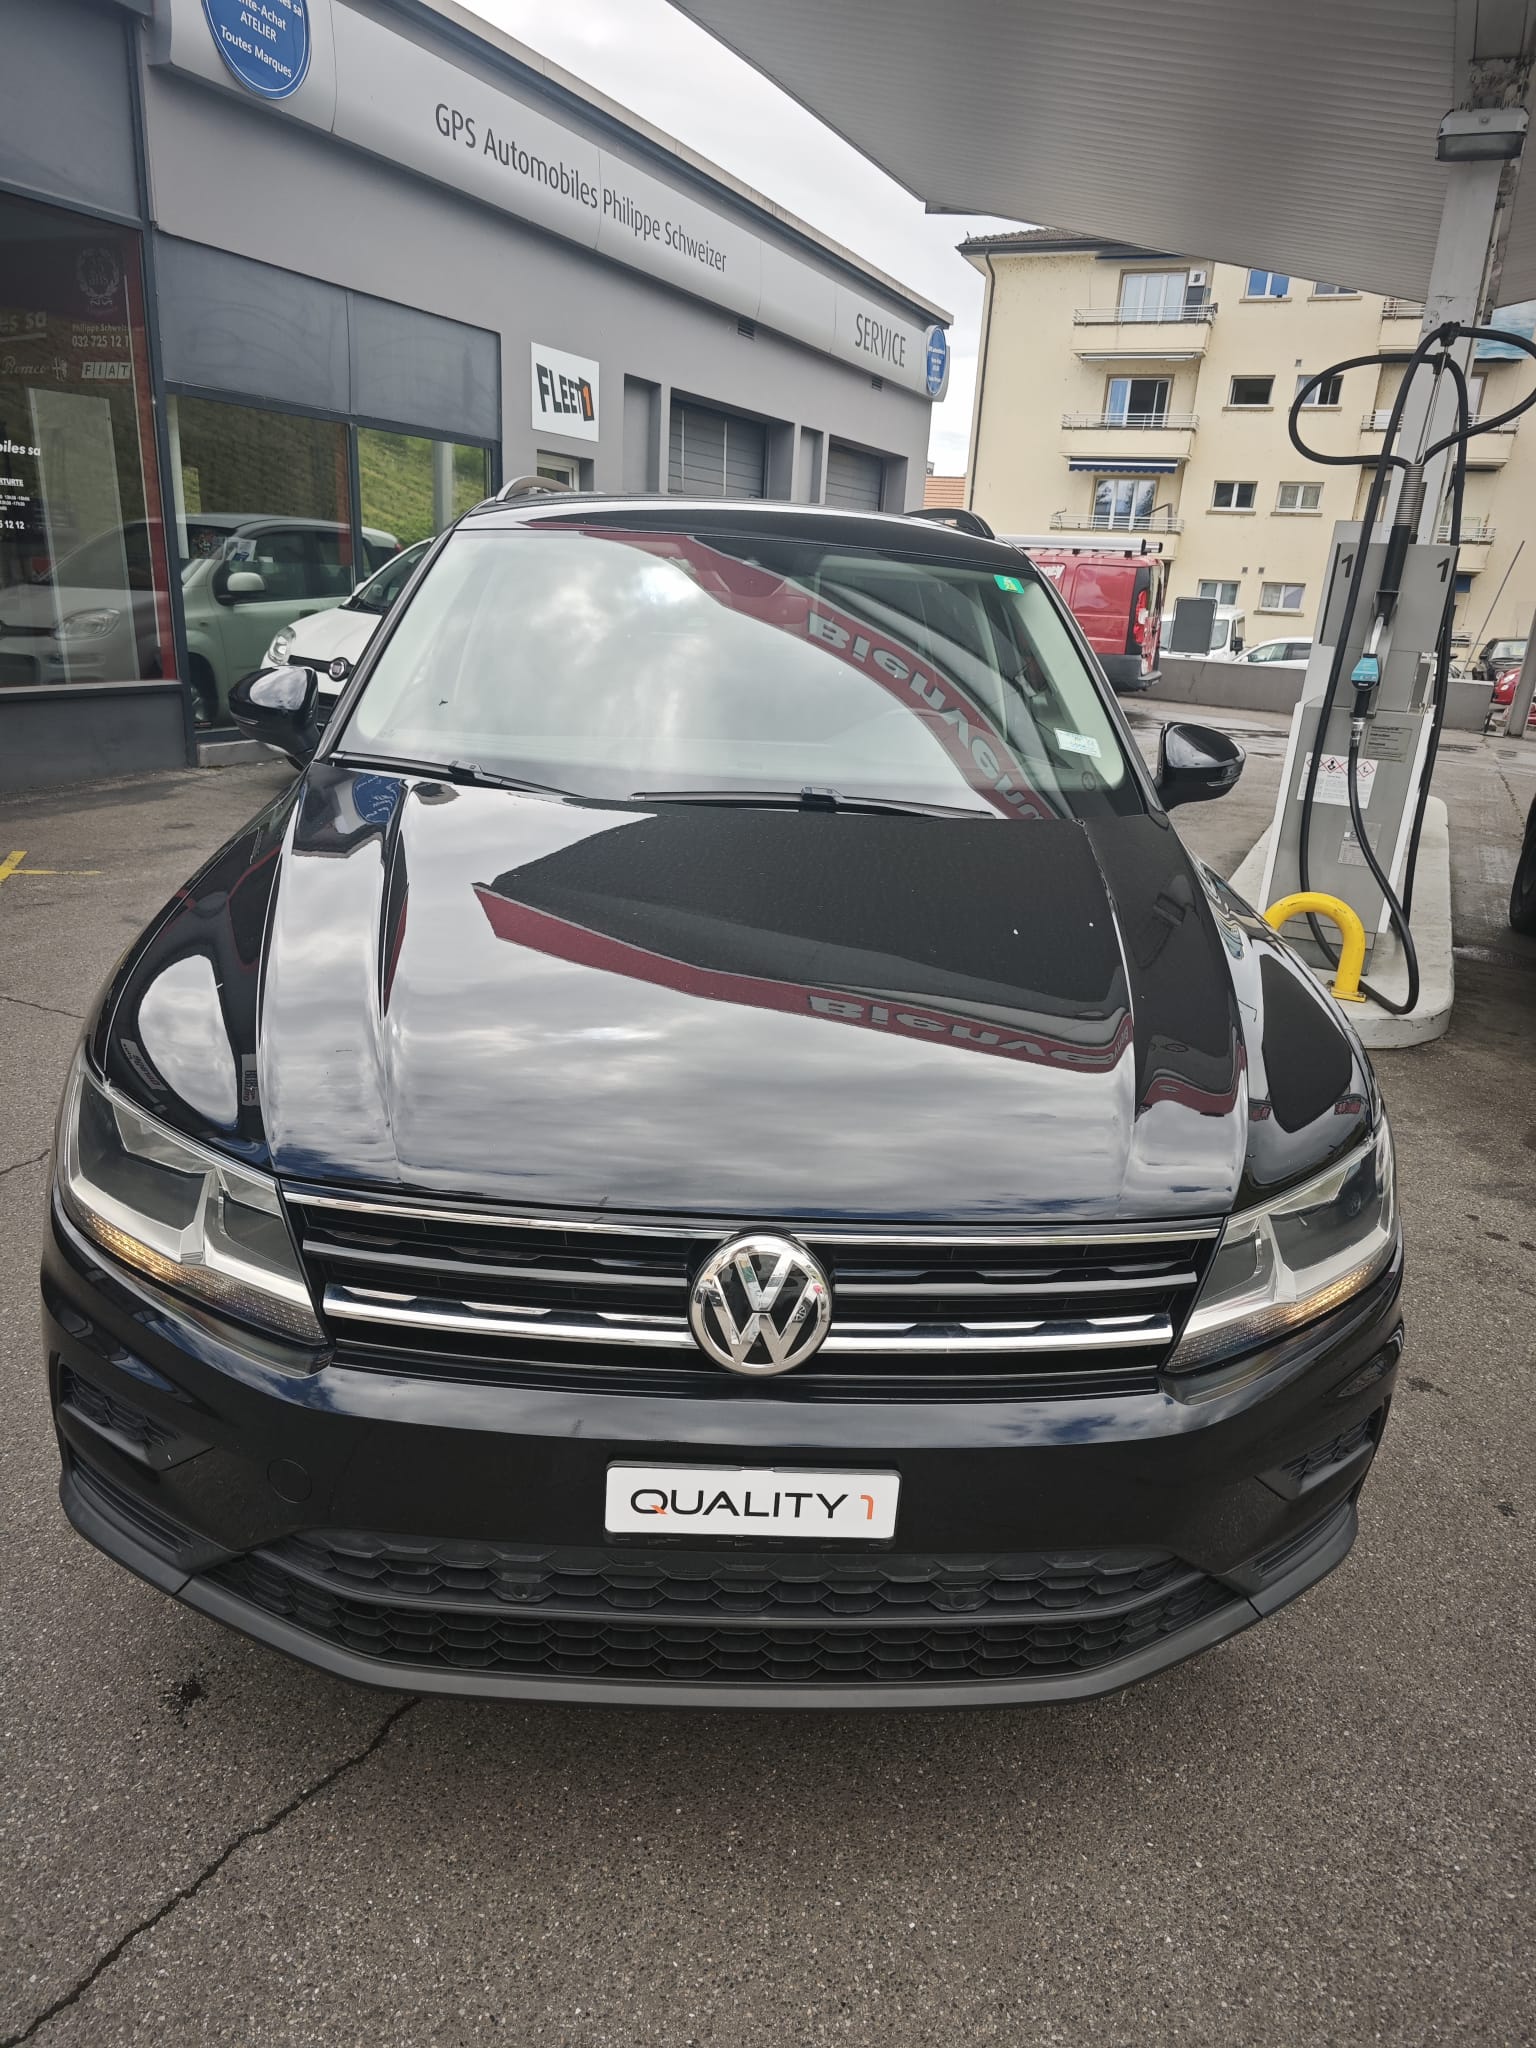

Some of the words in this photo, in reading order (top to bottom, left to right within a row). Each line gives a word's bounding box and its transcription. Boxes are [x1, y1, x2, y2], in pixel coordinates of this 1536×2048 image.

[240, 11, 277, 42] ATELIER
[220, 25, 253, 54] Toutes
[254, 46, 292, 78] Marques
[435, 103, 477, 149] GPS
[483, 128, 598, 209] Automobiles
[603, 188, 661, 241] Philippe
[664, 221, 727, 273] Schweizer
[72, 335, 89, 347] 032
[91, 335, 108, 347] 725
[855, 313, 907, 368] SERVICE
[83, 363, 130, 377] FIAT
[28, 447, 41, 456] sa
[1342, 554, 1354, 578] 1
[1437, 558, 1451, 582] 1
